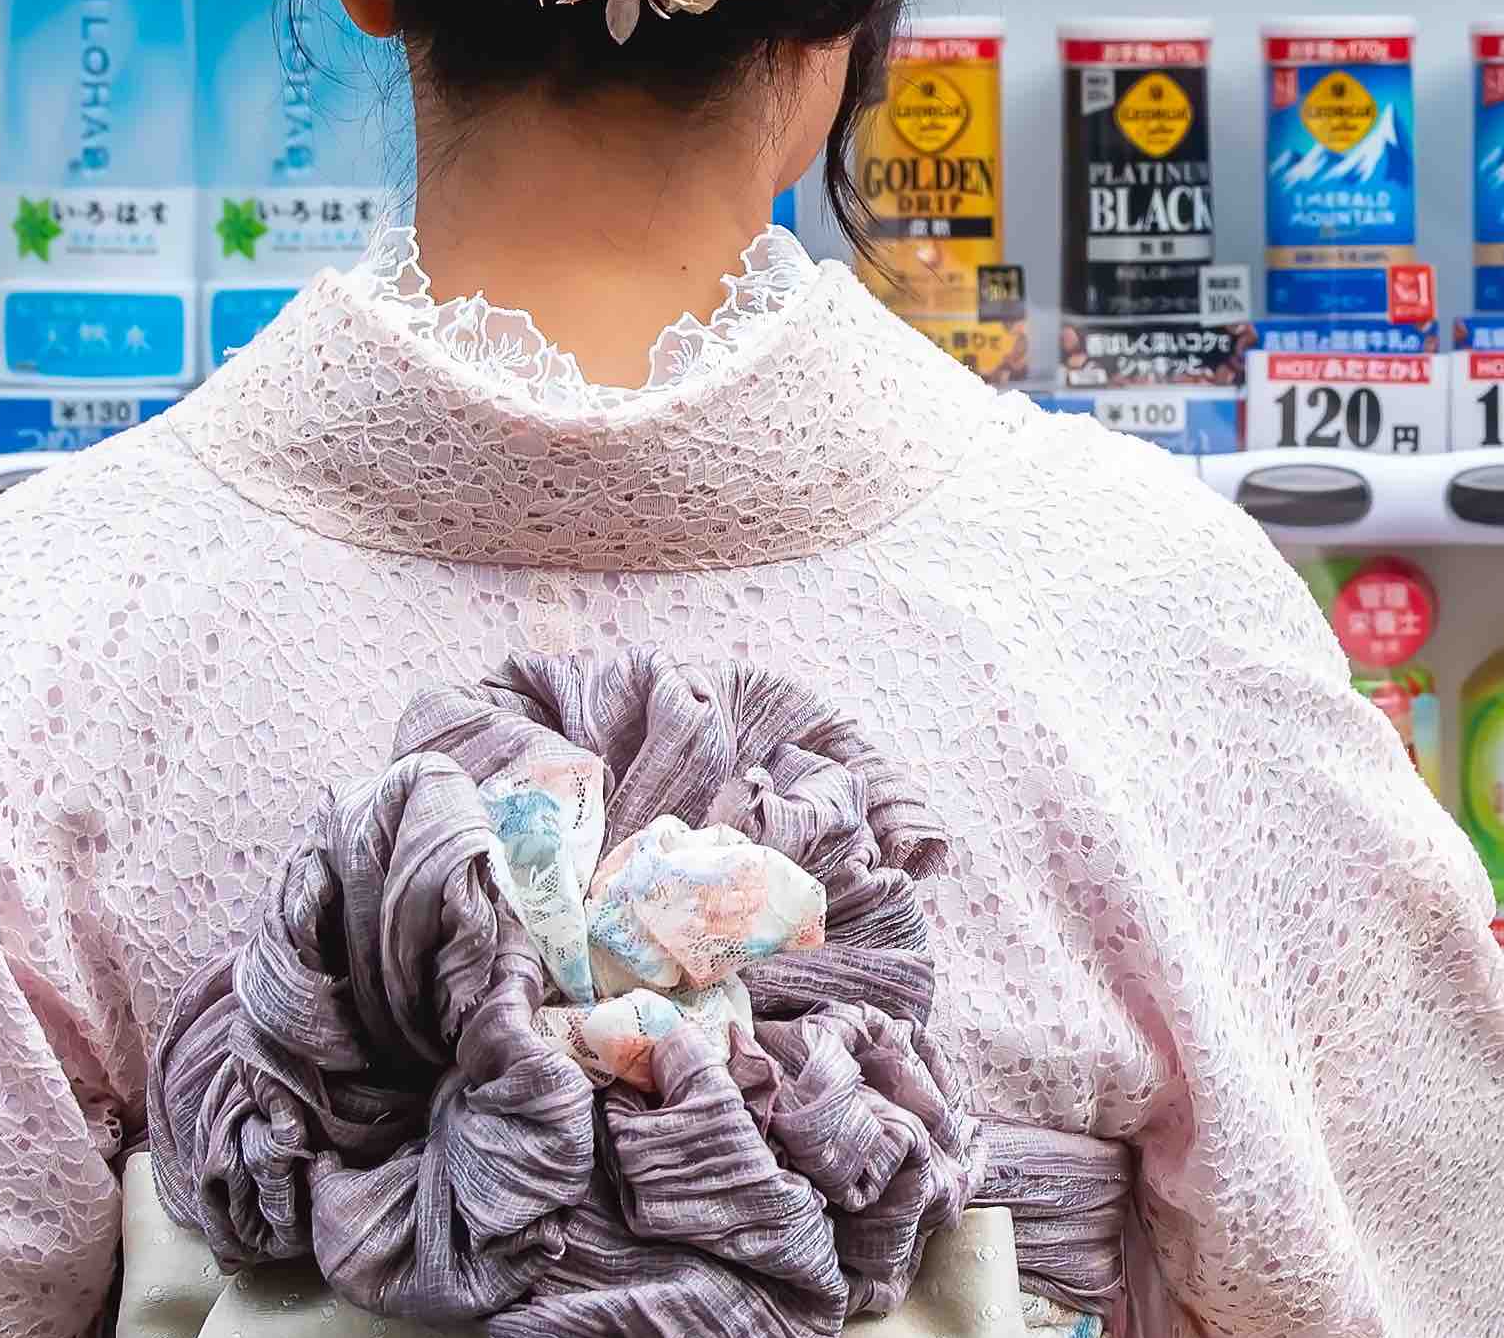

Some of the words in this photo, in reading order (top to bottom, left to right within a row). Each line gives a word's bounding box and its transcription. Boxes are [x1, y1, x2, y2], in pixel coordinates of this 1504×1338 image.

[862, 157, 994, 199] GOLDEN
[898, 195, 964, 212] DRIP
[1296, 192, 1390, 208] EMERALD
[1089, 187, 1214, 235] BLACK
[1292, 208, 1396, 225] MOUNTAIN
[1086, 334, 1231, 356] 香ばしく深いコクで
